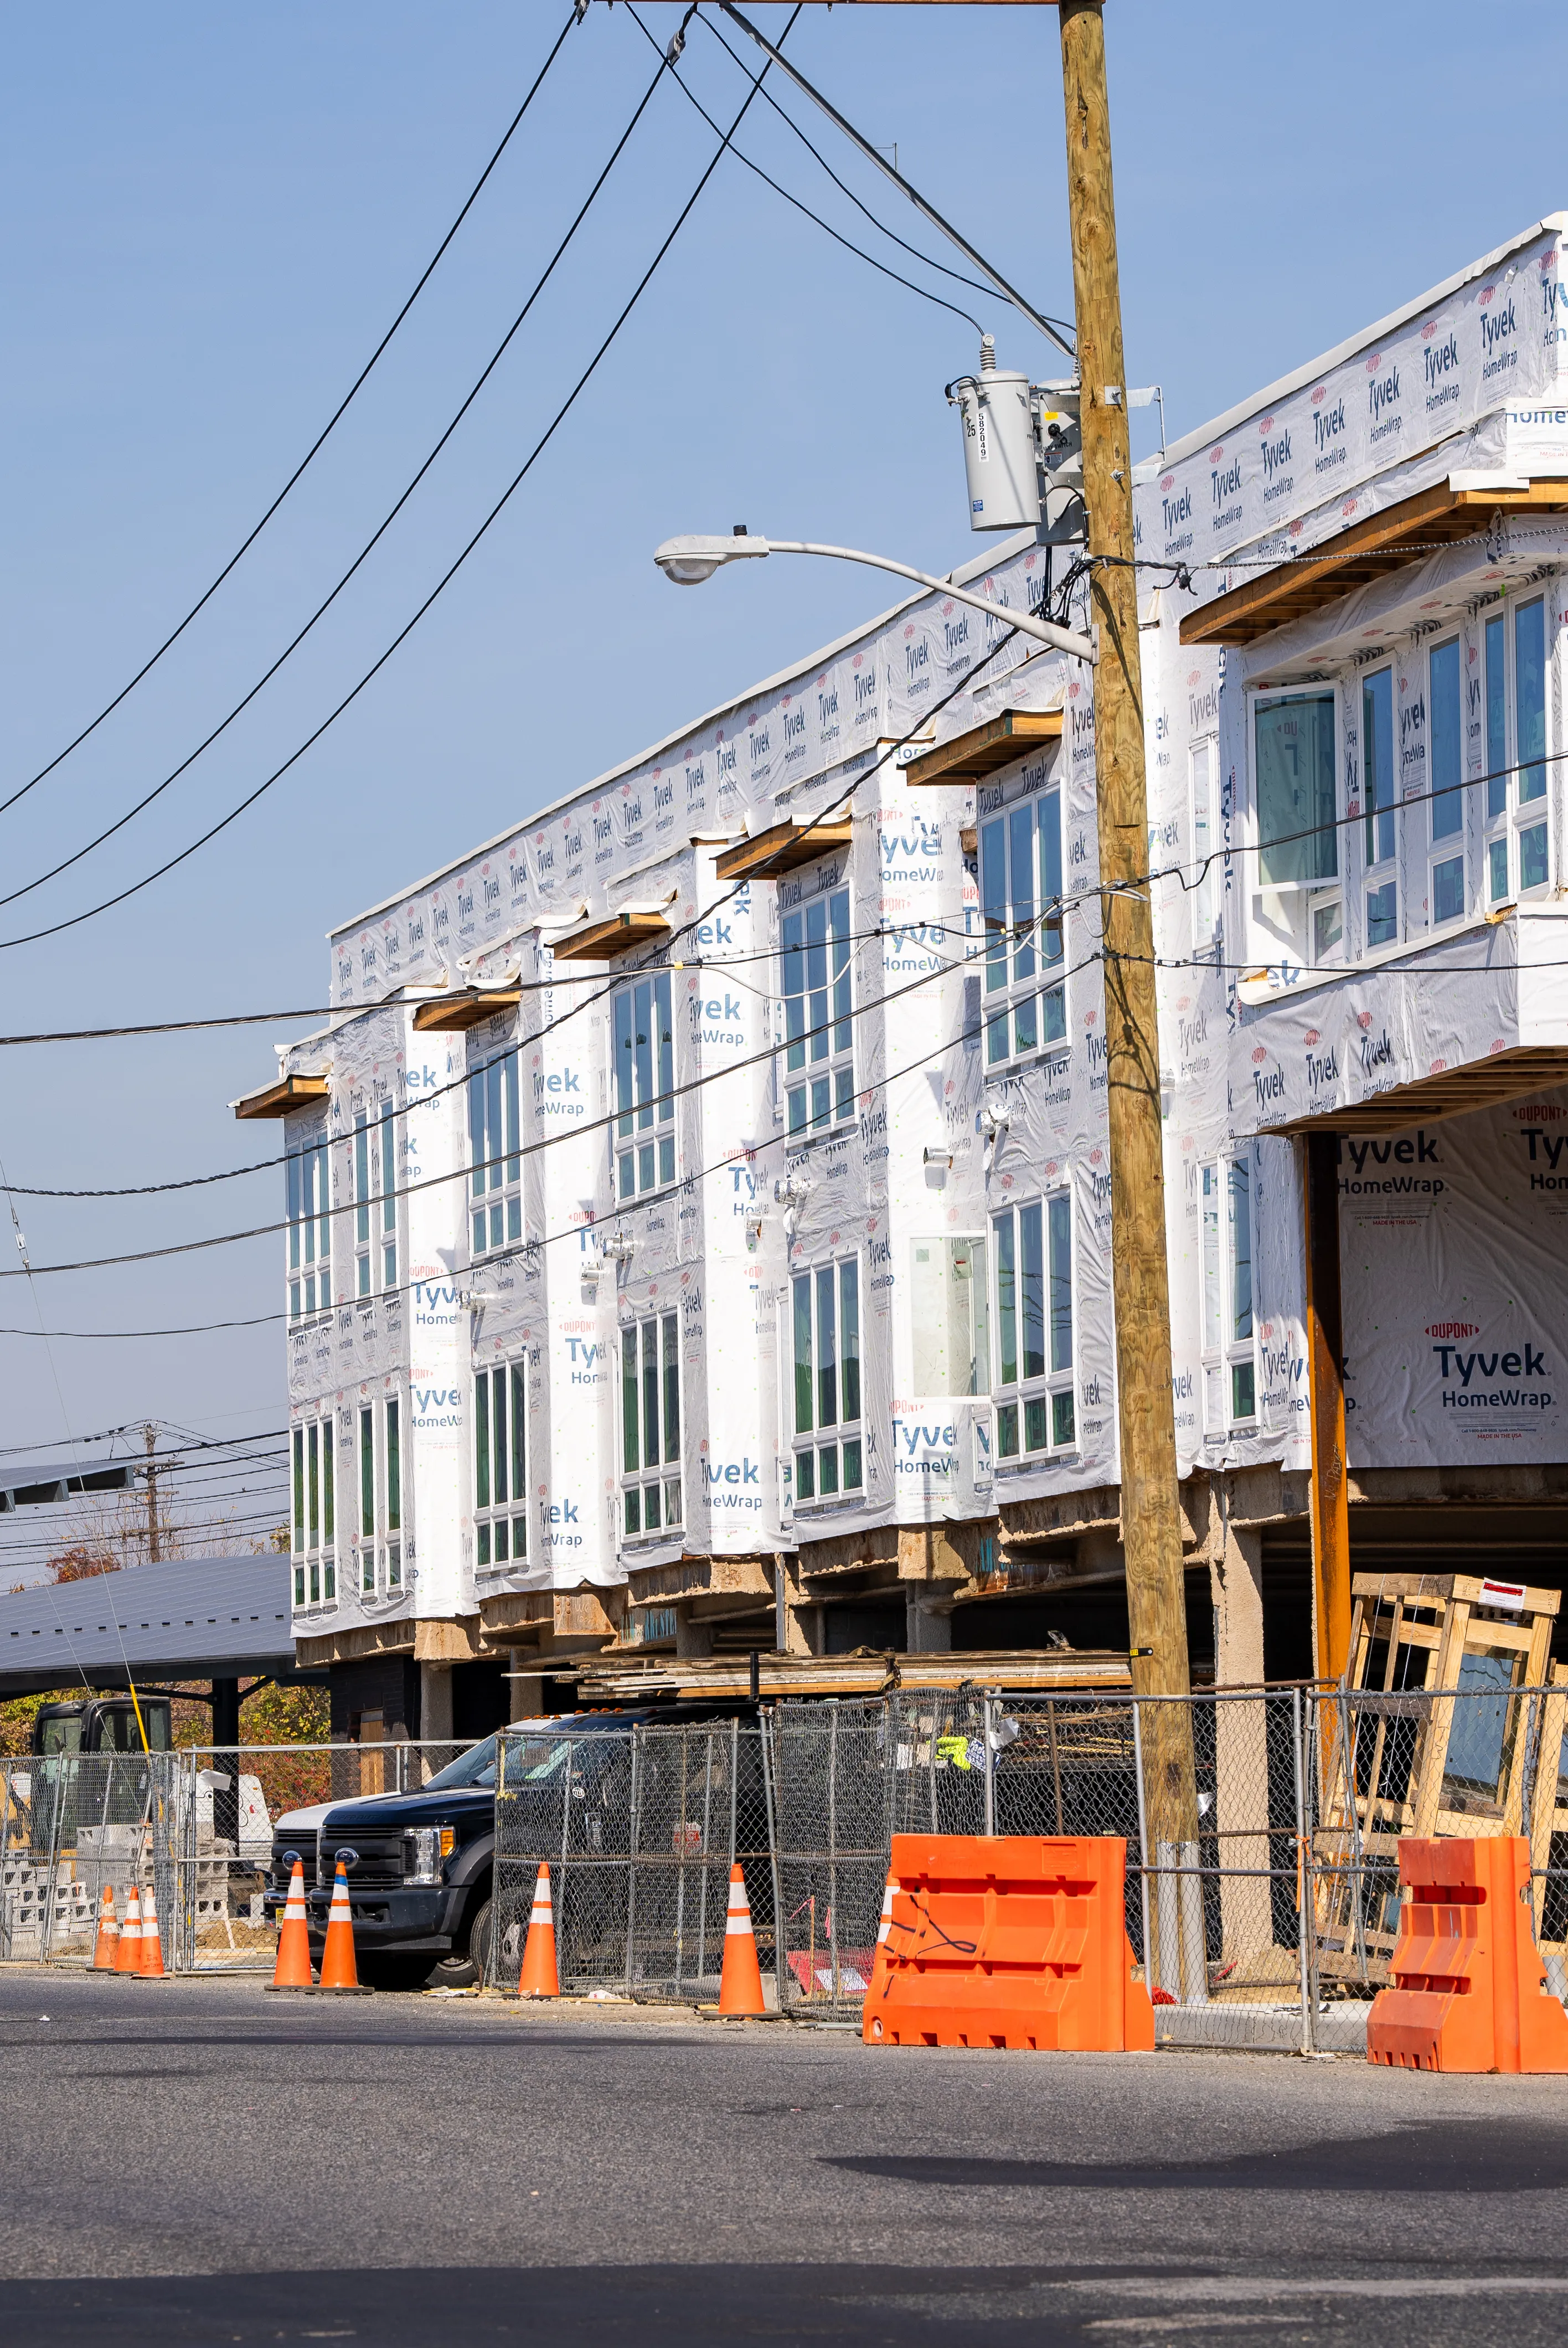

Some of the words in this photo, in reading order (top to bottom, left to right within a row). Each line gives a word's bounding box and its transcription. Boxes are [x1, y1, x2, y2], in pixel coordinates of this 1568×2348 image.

[1480, 298, 1516, 355] Tyvek
[1424, 333, 1458, 388] Tyvek
[1483, 349, 1517, 380] HomeWrap
[1369, 366, 1400, 420] Tyvek
[1426, 384, 1459, 414] HomeWrap
[967, 425, 976, 437] 25
[1313, 398, 1345, 451] Tyvek
[1370, 416, 1402, 444] HomeWrap
[1261, 429, 1291, 480] Tyvek
[1315, 446, 1346, 472] HomeWrap
[1211, 459, 1240, 509] Tyvek
[1264, 476, 1293, 503] HomeWrap
[1163, 487, 1191, 536] Tyvek
[1213, 505, 1242, 531] HomeWrap
[1165, 533, 1193, 558] HomeWrap
[945, 613, 968, 657] Tyvek
[905, 636, 929, 678] Tyvek
[947, 655, 970, 676] HomeWrap
[819, 685, 838, 725] Tyvek
[854, 666, 876, 707] Tyvek
[907, 677, 929, 698] HomeWrap
[783, 705, 805, 745] Tyvek
[1189, 683, 1218, 731] Tyvek
[750, 725, 770, 763] Tyvek
[654, 778, 673, 816] Tyvek
[685, 760, 704, 798] Tyvek
[594, 811, 611, 847] Tyvek
[623, 795, 642, 832] Tyvek
[537, 843, 554, 875] Tyvek
[565, 828, 581, 863] Tyvek
[483, 874, 499, 908] Tyvek
[510, 859, 527, 892] Tyvek
[433, 902, 448, 935] Tyvek
[458, 888, 473, 922] Tyvek
[409, 916, 424, 949] Tyvek
[1179, 1010, 1207, 1057] Tyvek
[1306, 1046, 1339, 1093] Tyvek
[1361, 1030, 1391, 1078] Tyvek
[1254, 1062, 1285, 1110] Tyvek
[1519, 1105, 1562, 1121] DUPONT
[1338, 1175, 1445, 1196] HomeWrap
[868, 1233, 891, 1272] Tyvek
[1432, 1323, 1474, 1339] DUPONT
[1433, 1343, 1544, 1387] Tyvek
[1443, 1390, 1551, 1412] HomeWrap
